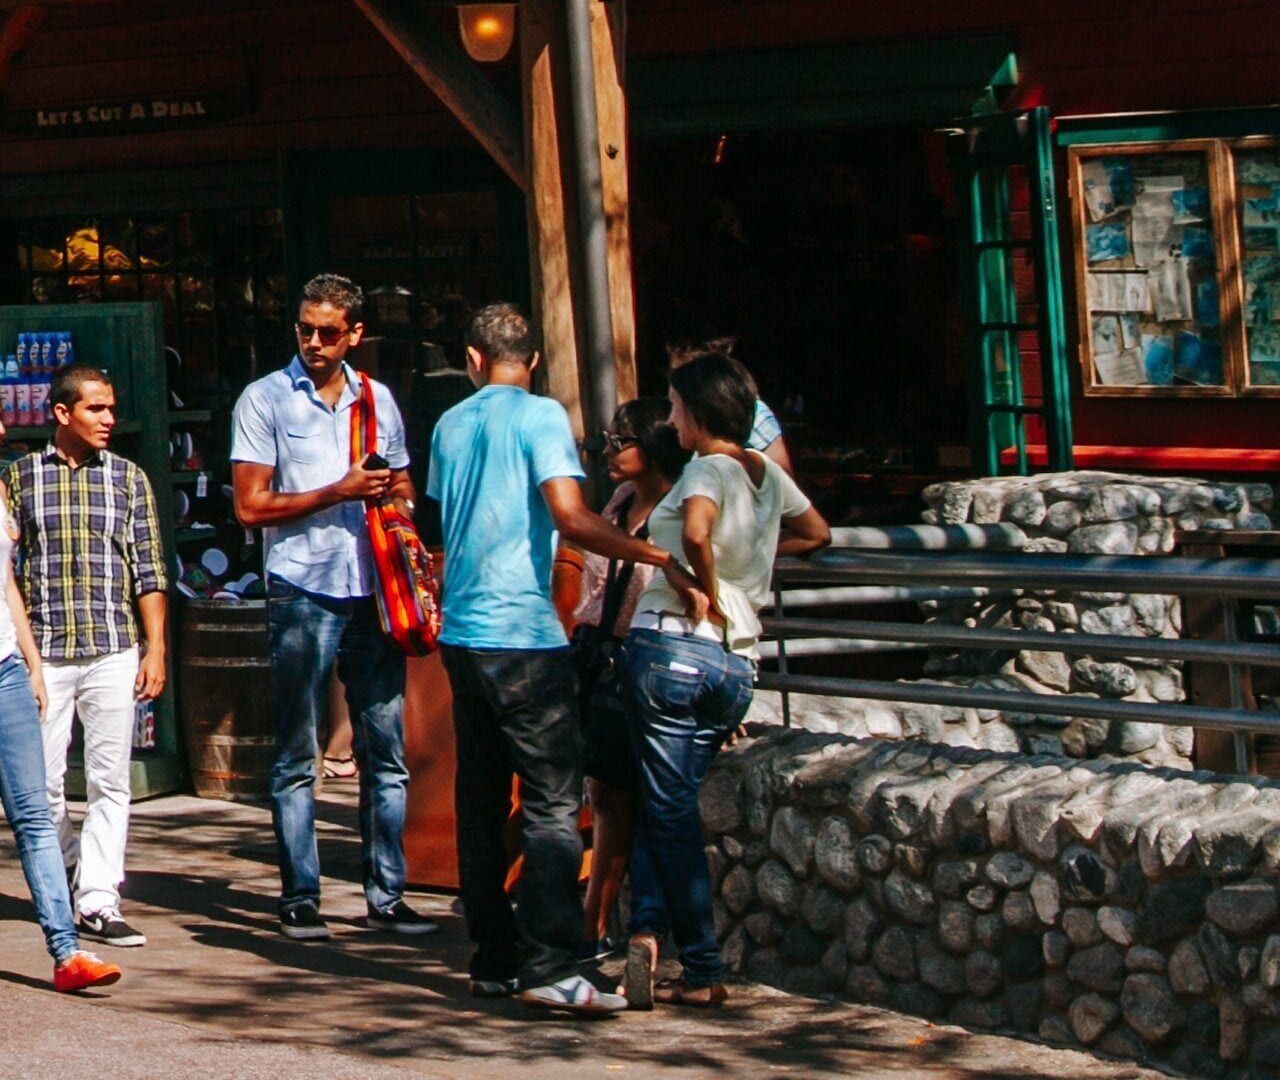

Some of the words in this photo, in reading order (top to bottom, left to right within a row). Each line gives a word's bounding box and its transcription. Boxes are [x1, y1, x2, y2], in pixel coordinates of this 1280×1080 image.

[87, 106, 123, 123] CUT
[129, 102, 145, 119] A
[151, 100, 206, 117] DEAL
